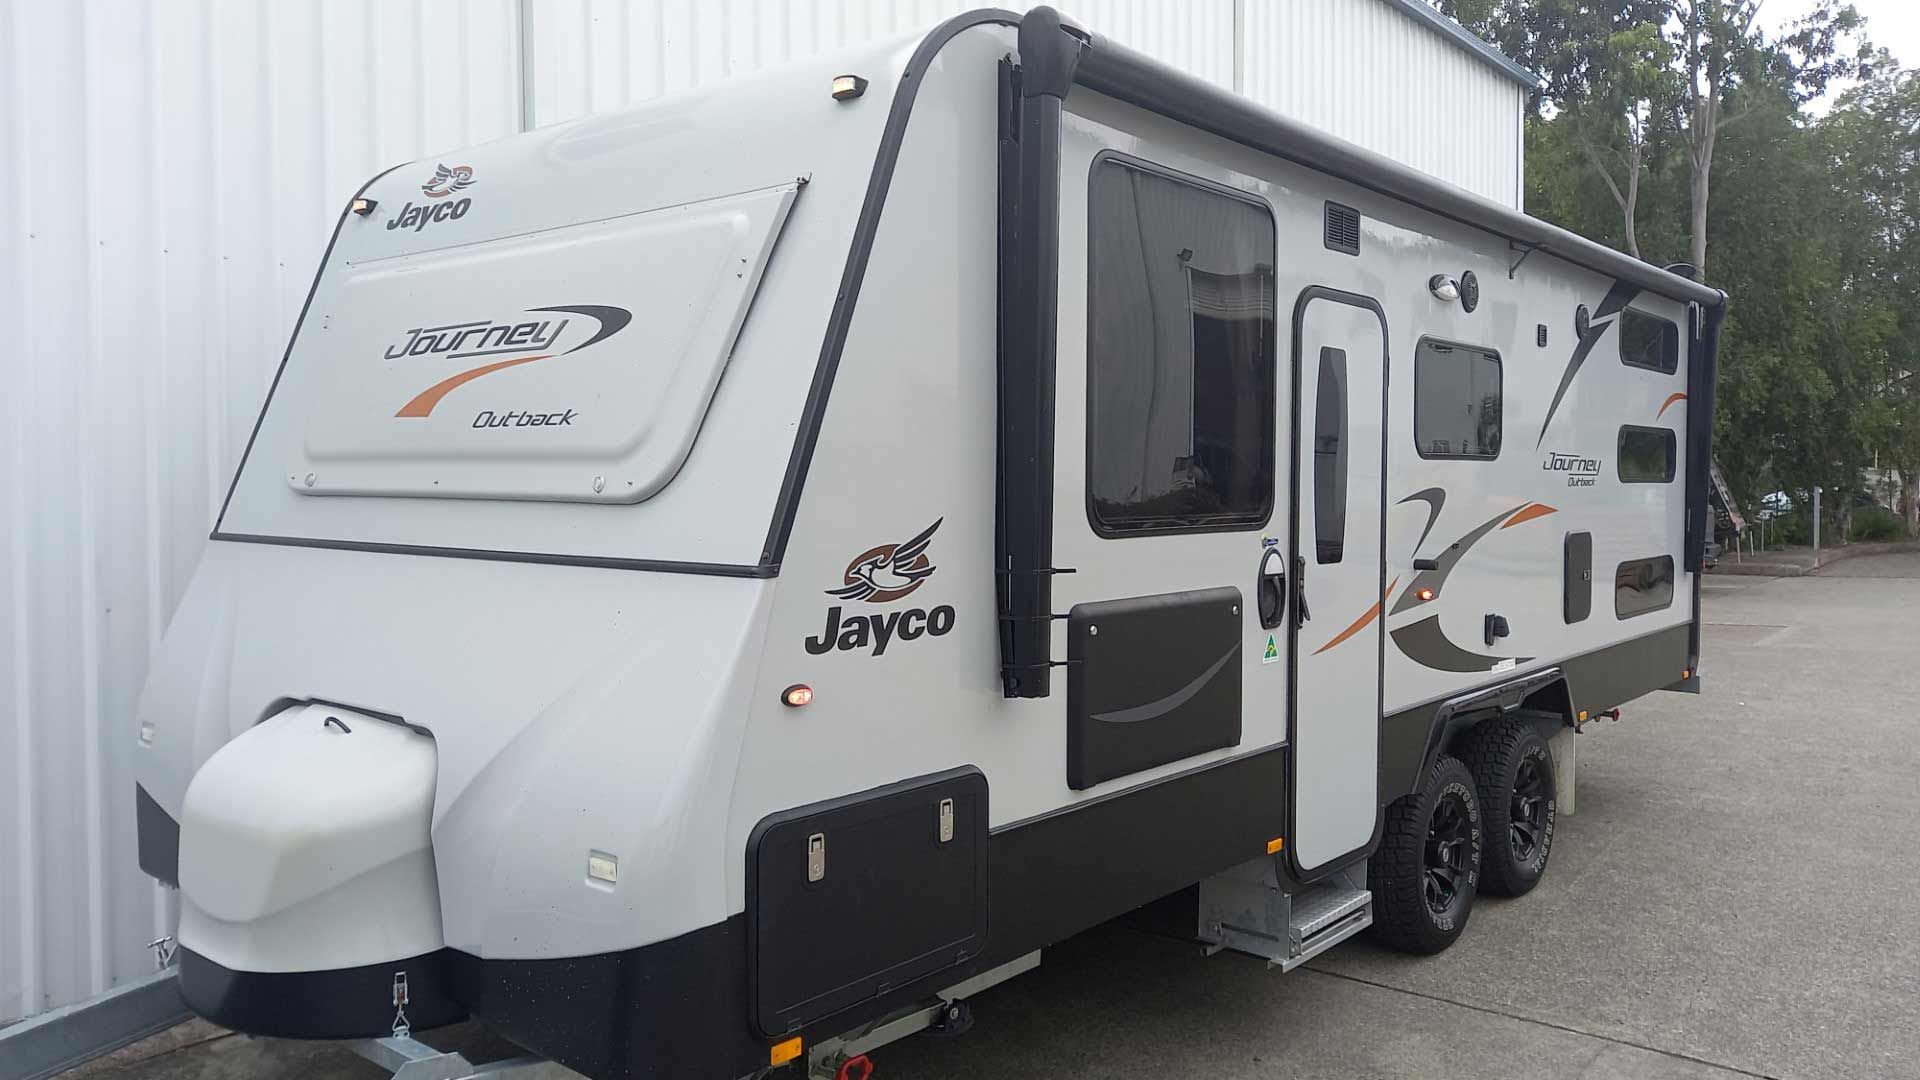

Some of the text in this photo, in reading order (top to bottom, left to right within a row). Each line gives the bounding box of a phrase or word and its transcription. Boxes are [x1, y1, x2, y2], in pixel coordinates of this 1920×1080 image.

[386, 198, 472, 233] Jayco
[383, 318, 570, 360] Journey
[472, 408, 580, 429] Outback
[1542, 452, 1602, 476] Journey
[1567, 476, 1597, 487] Outback
[804, 604, 956, 657] Jayco
